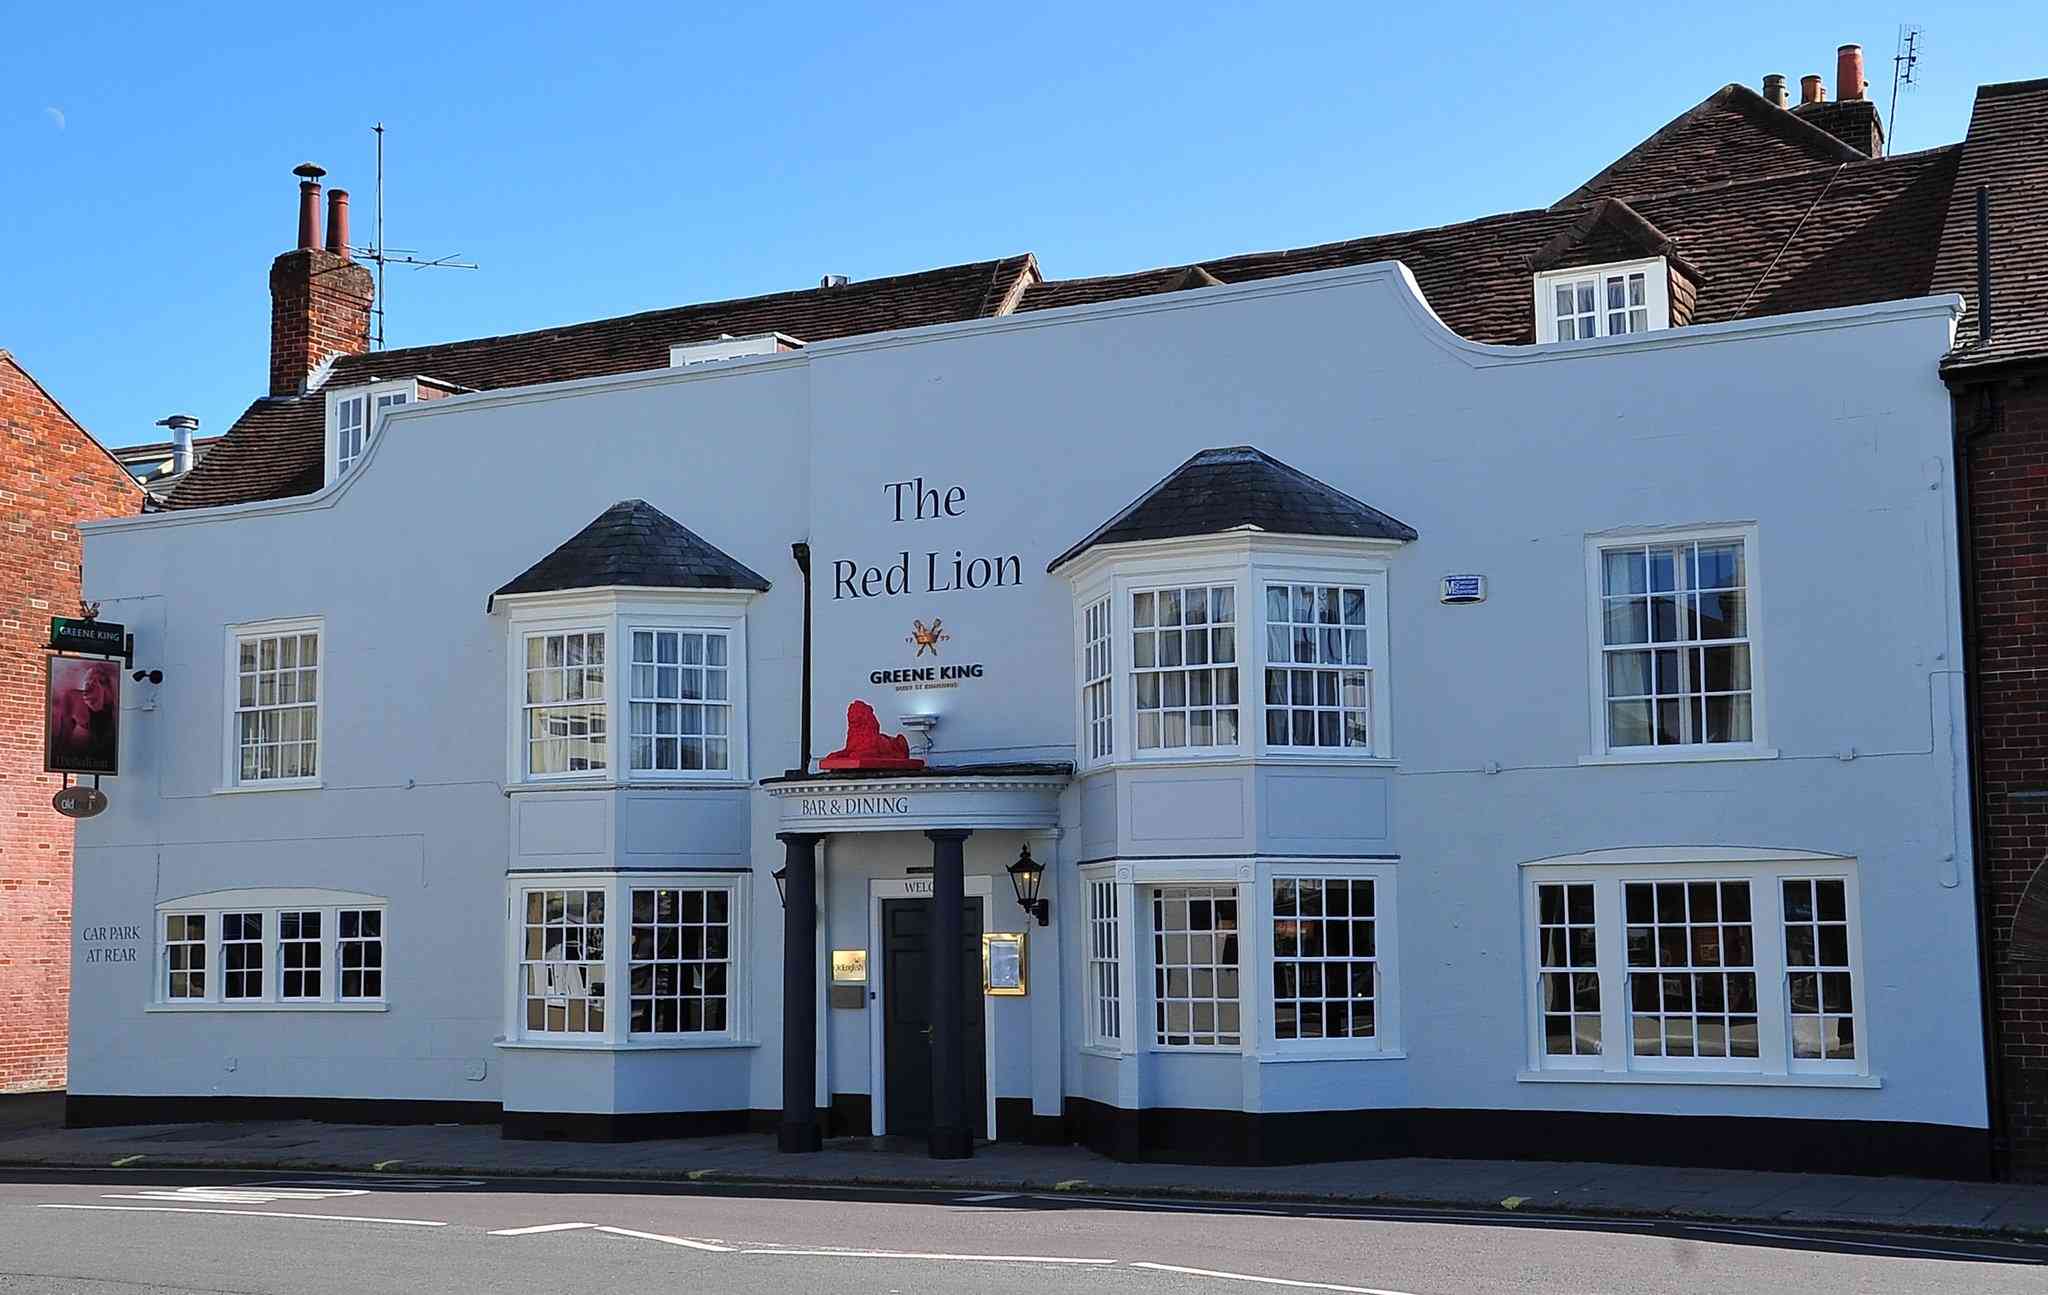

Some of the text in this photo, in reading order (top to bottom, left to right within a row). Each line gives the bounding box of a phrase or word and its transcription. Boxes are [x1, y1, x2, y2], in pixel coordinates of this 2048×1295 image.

[884, 477, 966, 522] The
[832, 550, 1023, 600] Red Lion
[60, 626, 121, 641] GREENE KING
[870, 664, 984, 684] GREENE KING
[803, 797, 909, 815] BAR & DINING
[905, 881, 932, 893] WELC
[83, 925, 141, 940] CAR PARK
[86, 948, 136, 962] AT REAR
